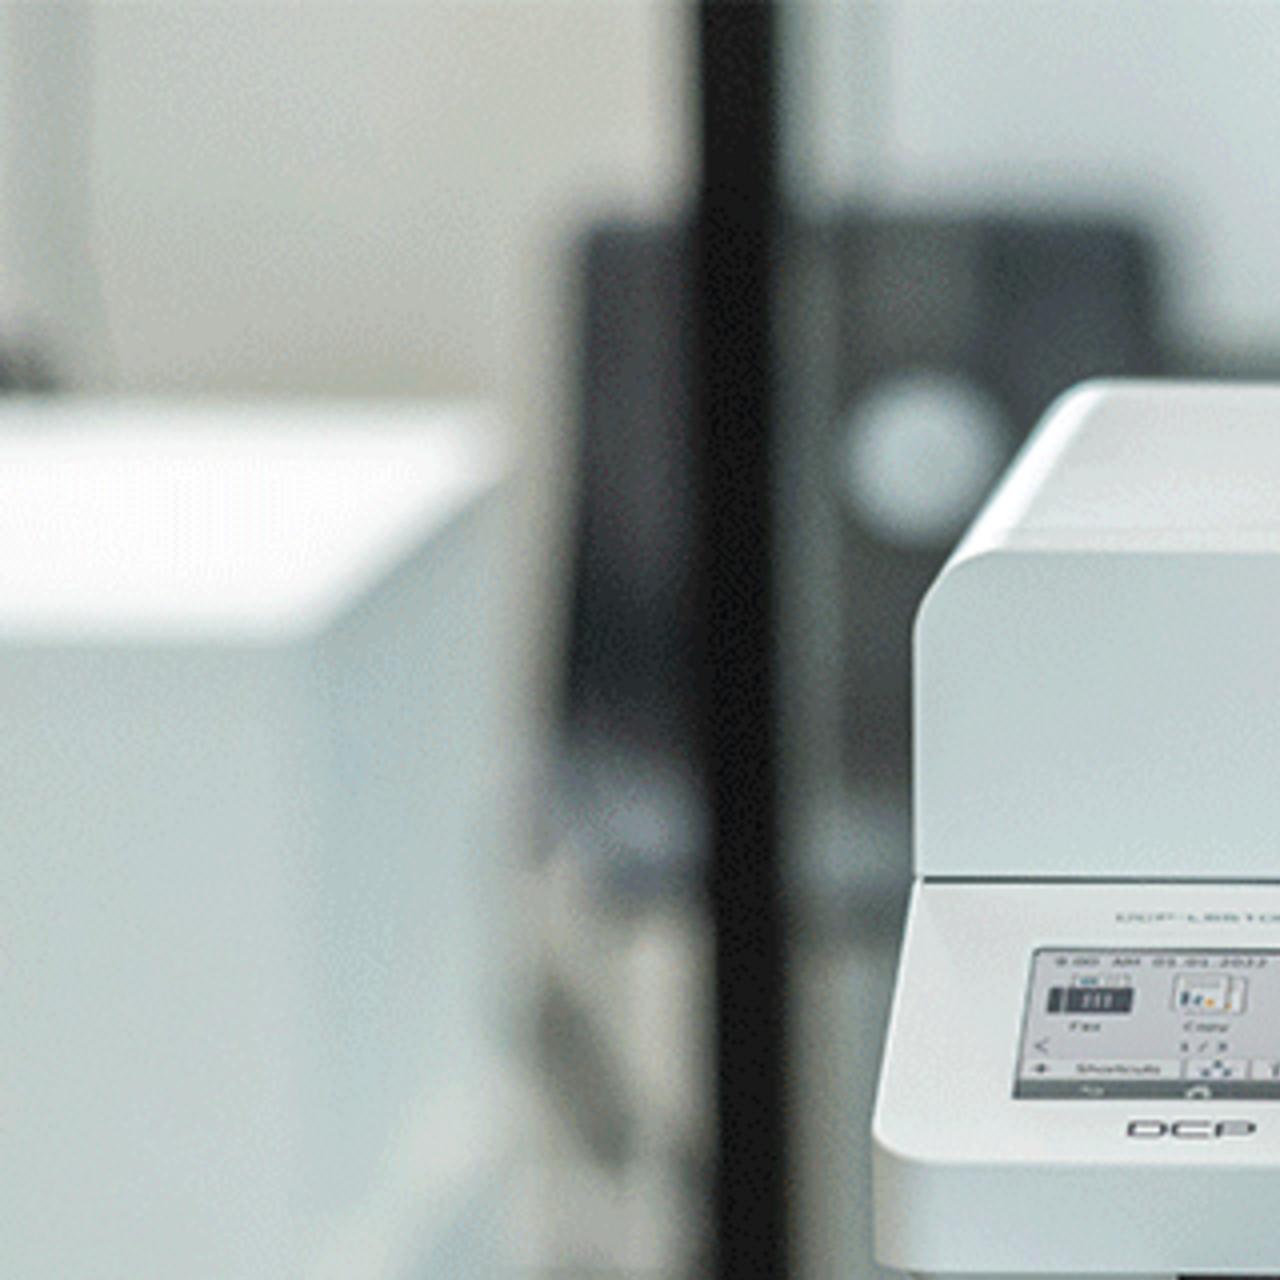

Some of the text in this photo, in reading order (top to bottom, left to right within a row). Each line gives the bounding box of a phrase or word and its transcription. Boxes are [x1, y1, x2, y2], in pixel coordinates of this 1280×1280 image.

[1069, 1021, 1101, 1034] Fax
[1183, 1021, 1229, 1035] Copy
[1126, 1120, 1257, 1139] DCP
